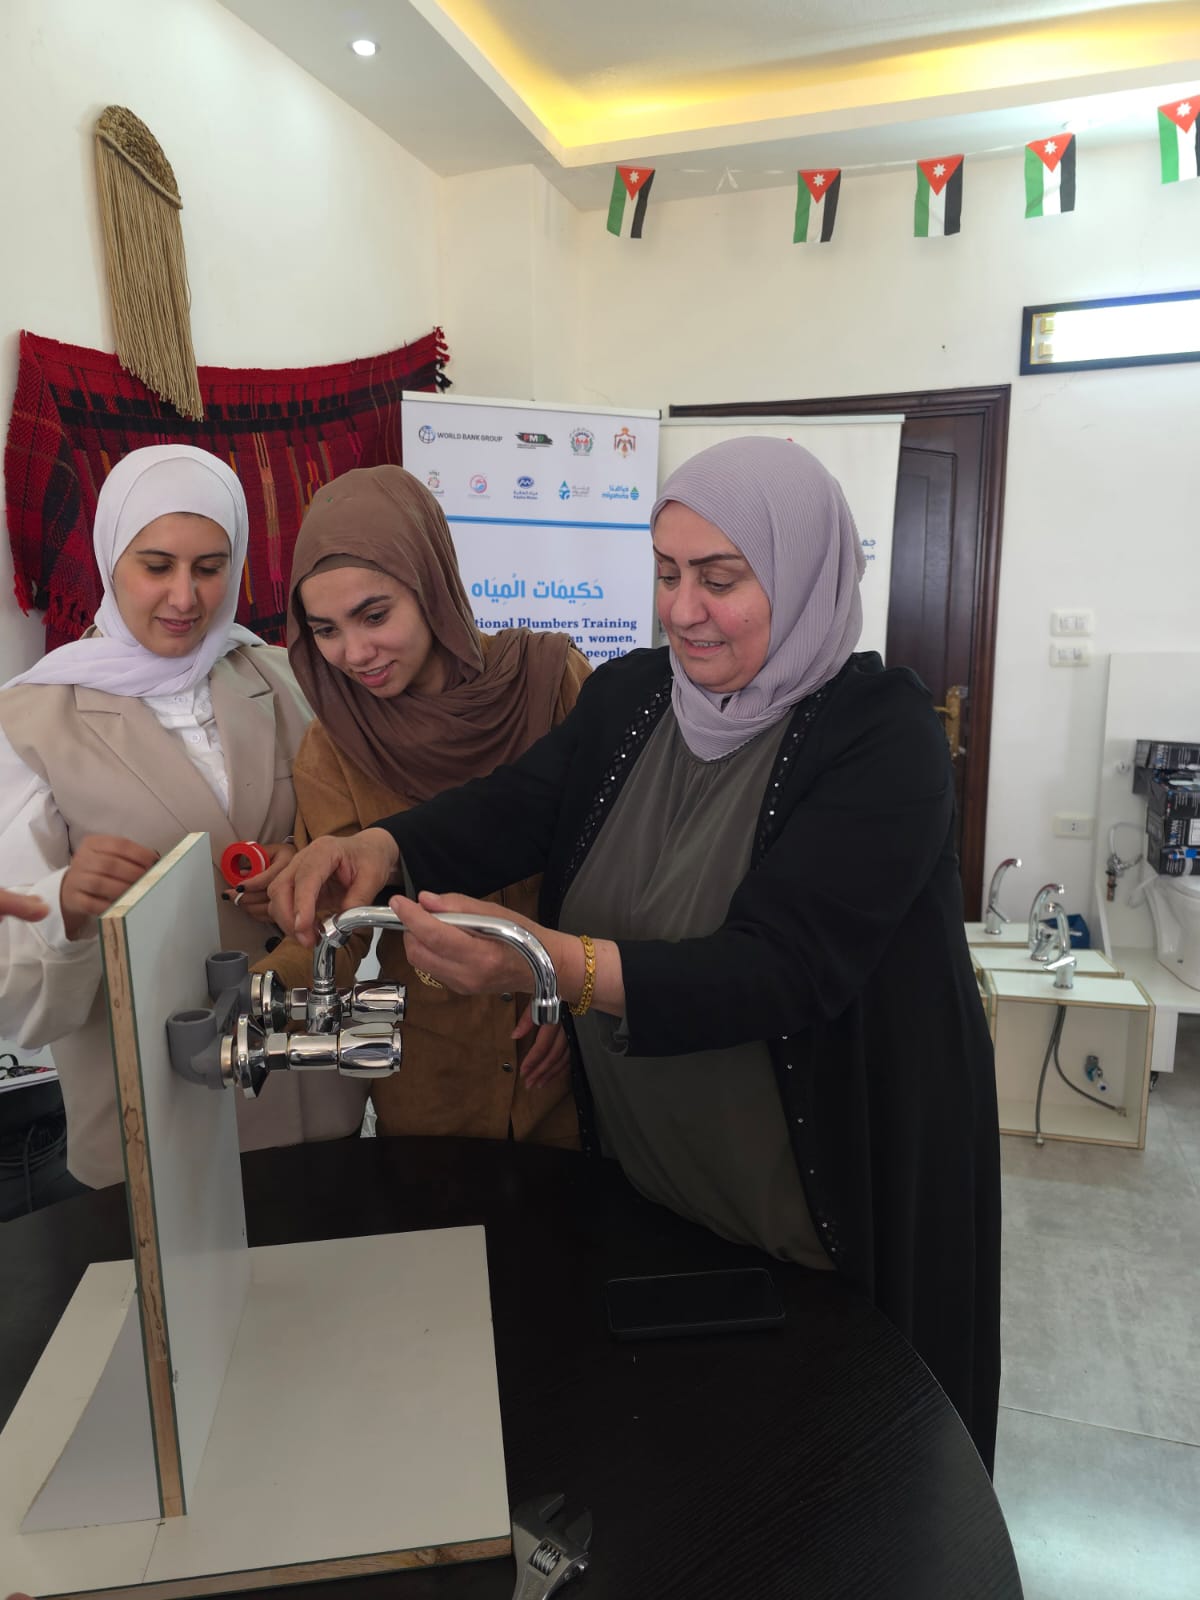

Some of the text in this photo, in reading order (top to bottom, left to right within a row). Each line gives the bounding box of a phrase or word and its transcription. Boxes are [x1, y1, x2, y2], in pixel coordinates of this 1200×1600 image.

[437, 432, 503, 442] WORLD BANK GROUP
[474, 618, 637, 631] tional Plumbers Training
[588, 634, 637, 644] women,
